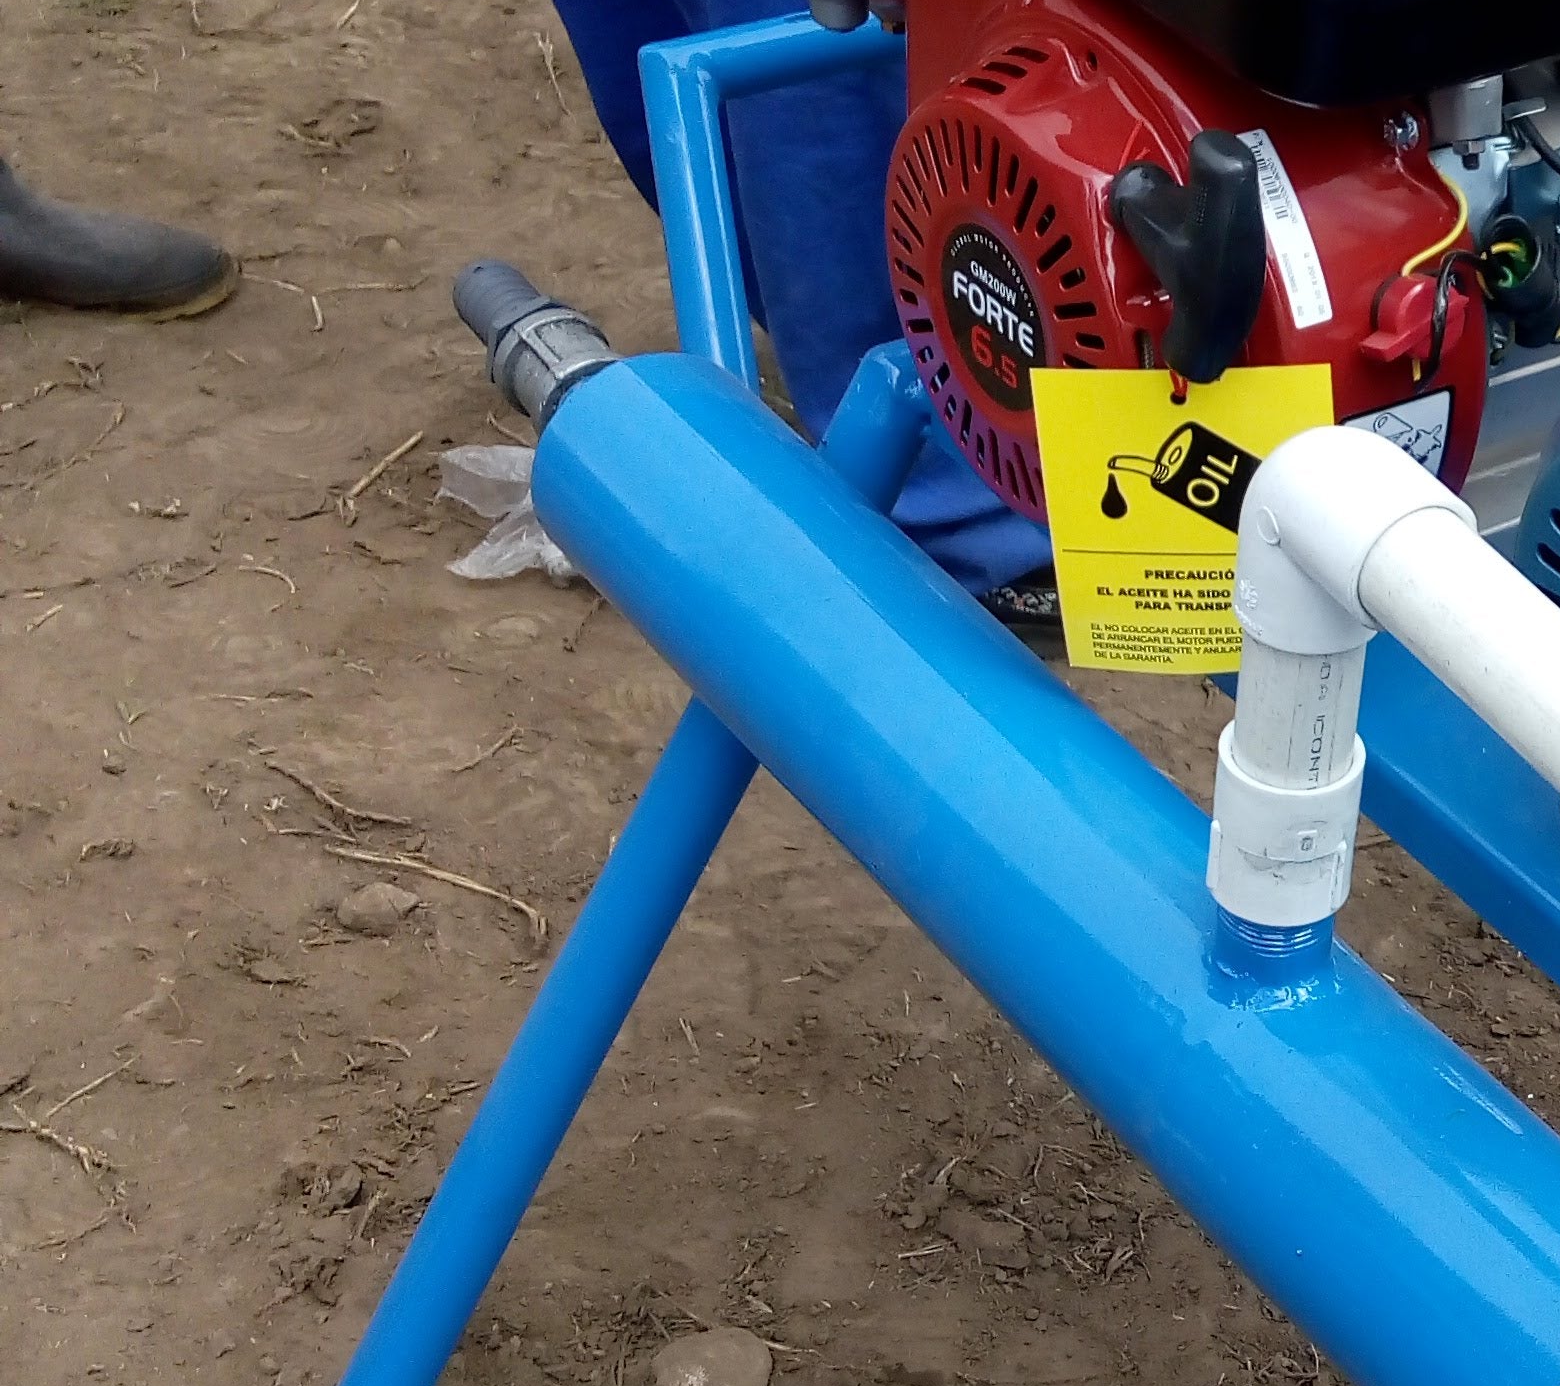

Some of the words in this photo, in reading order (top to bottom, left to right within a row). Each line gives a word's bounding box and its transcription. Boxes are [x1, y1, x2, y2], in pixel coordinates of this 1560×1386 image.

[970, 260, 1018, 307] GM200W
[952, 270, 1035, 358] FORTE
[970, 324, 1018, 389] 6.5
[1187, 454, 1239, 507] OIL
[1144, 568, 1235, 581] PRECAUCIÓ
[1097, 586, 1114, 596] EL
[1118, 587, 1169, 599] ACEITE
[1173, 588, 1193, 599] HA
[1197, 589, 1231, 599] SIDO
[1135, 600, 1172, 611] PARA
[1175, 601, 1233, 612] TRANSP
[1105, 623, 1119, 633] NO
[1121, 624, 1168, 635] COLOCAR
[1171, 626, 1205, 636] ACEITE
[1208, 626, 1222, 635] EN
[1224, 626, 1237, 635] EL
[1091, 631, 1105, 641] DE
[1107, 633, 1161, 644] ARRANCAR
[1163, 635, 1175, 645] EL
[1177, 636, 1213, 645] MOTOR
[1215, 636, 1243, 645] PUED
[1093, 641, 1193, 655] PERMANENTEMENTE
[1194, 646, 1202, 655] Y
[1094, 650, 1107, 659] DE
[1109, 650, 1122, 660] LA
